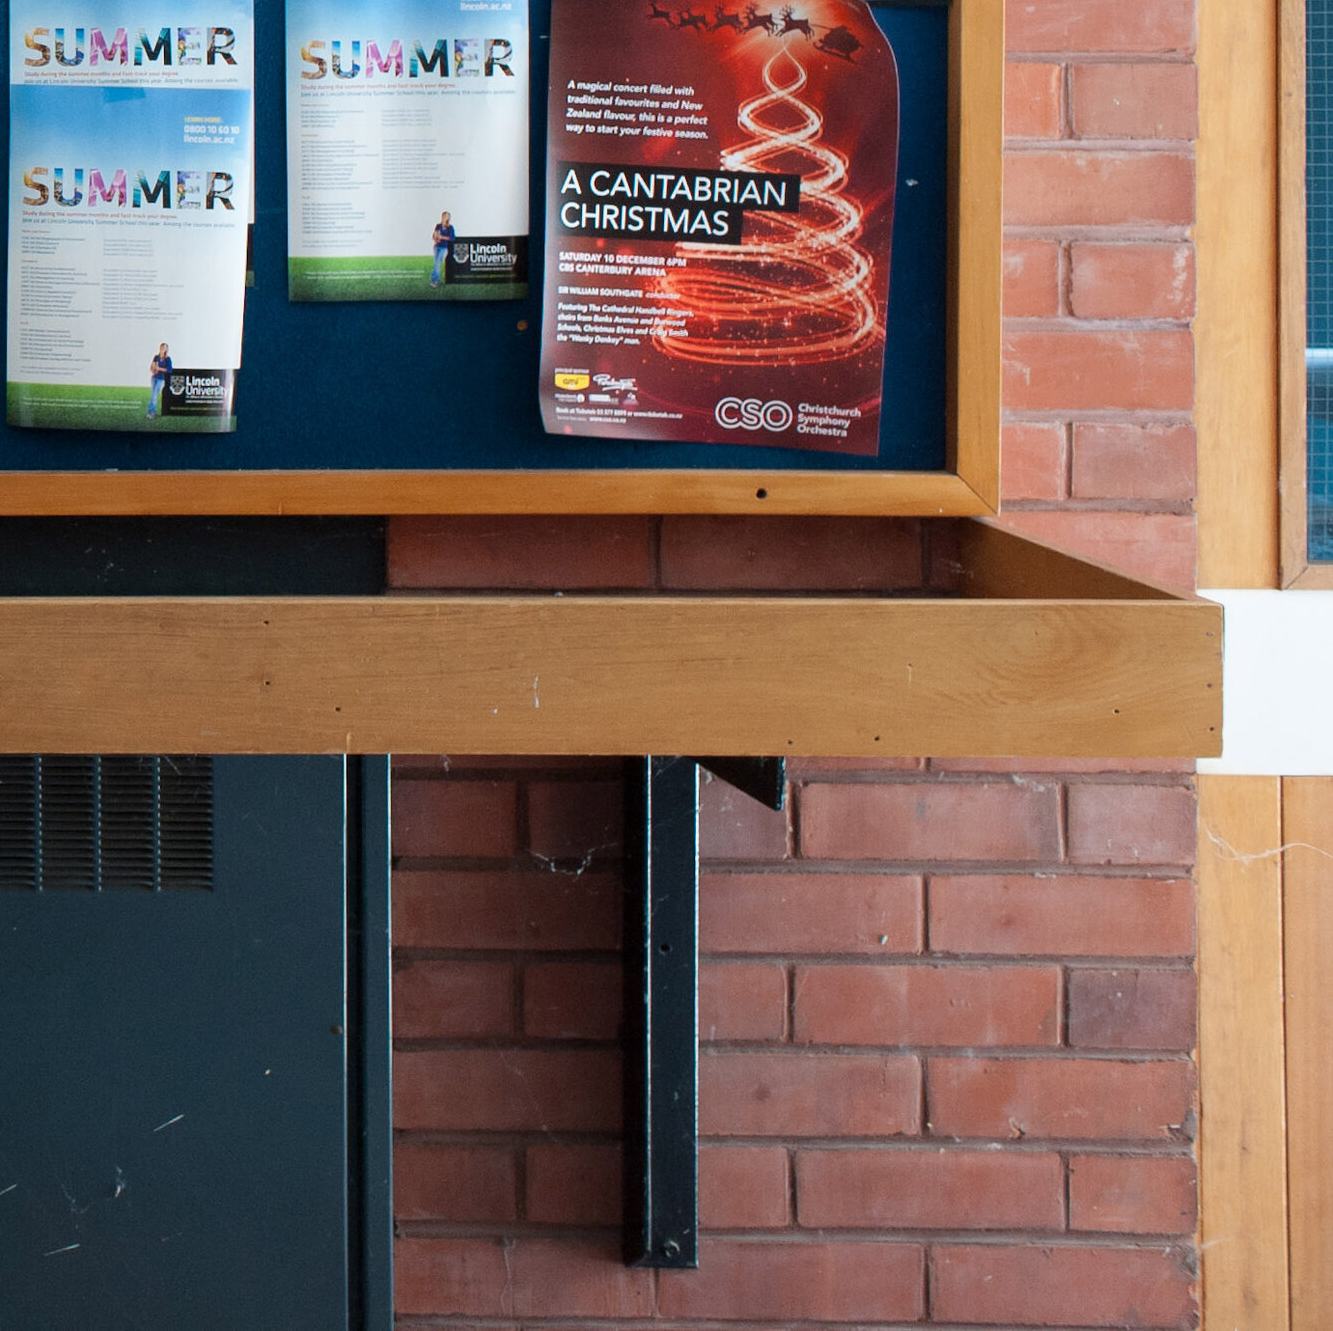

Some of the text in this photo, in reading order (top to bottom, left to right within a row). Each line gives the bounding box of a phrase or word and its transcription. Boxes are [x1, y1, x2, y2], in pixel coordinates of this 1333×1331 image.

[23, 27, 238, 67] SUMMER
[301, 38, 515, 79] SUMMER
[22, 167, 235, 210] SUMMER
[561, 169, 786, 205] A CANTABRIAN
[561, 202, 728, 236] CHRISTMAS
[715, 397, 793, 432] CSO
[797, 414, 850, 431] Symphony
[798, 403, 861, 417] Christchurch
[797, 424, 847, 437] Orchestra
